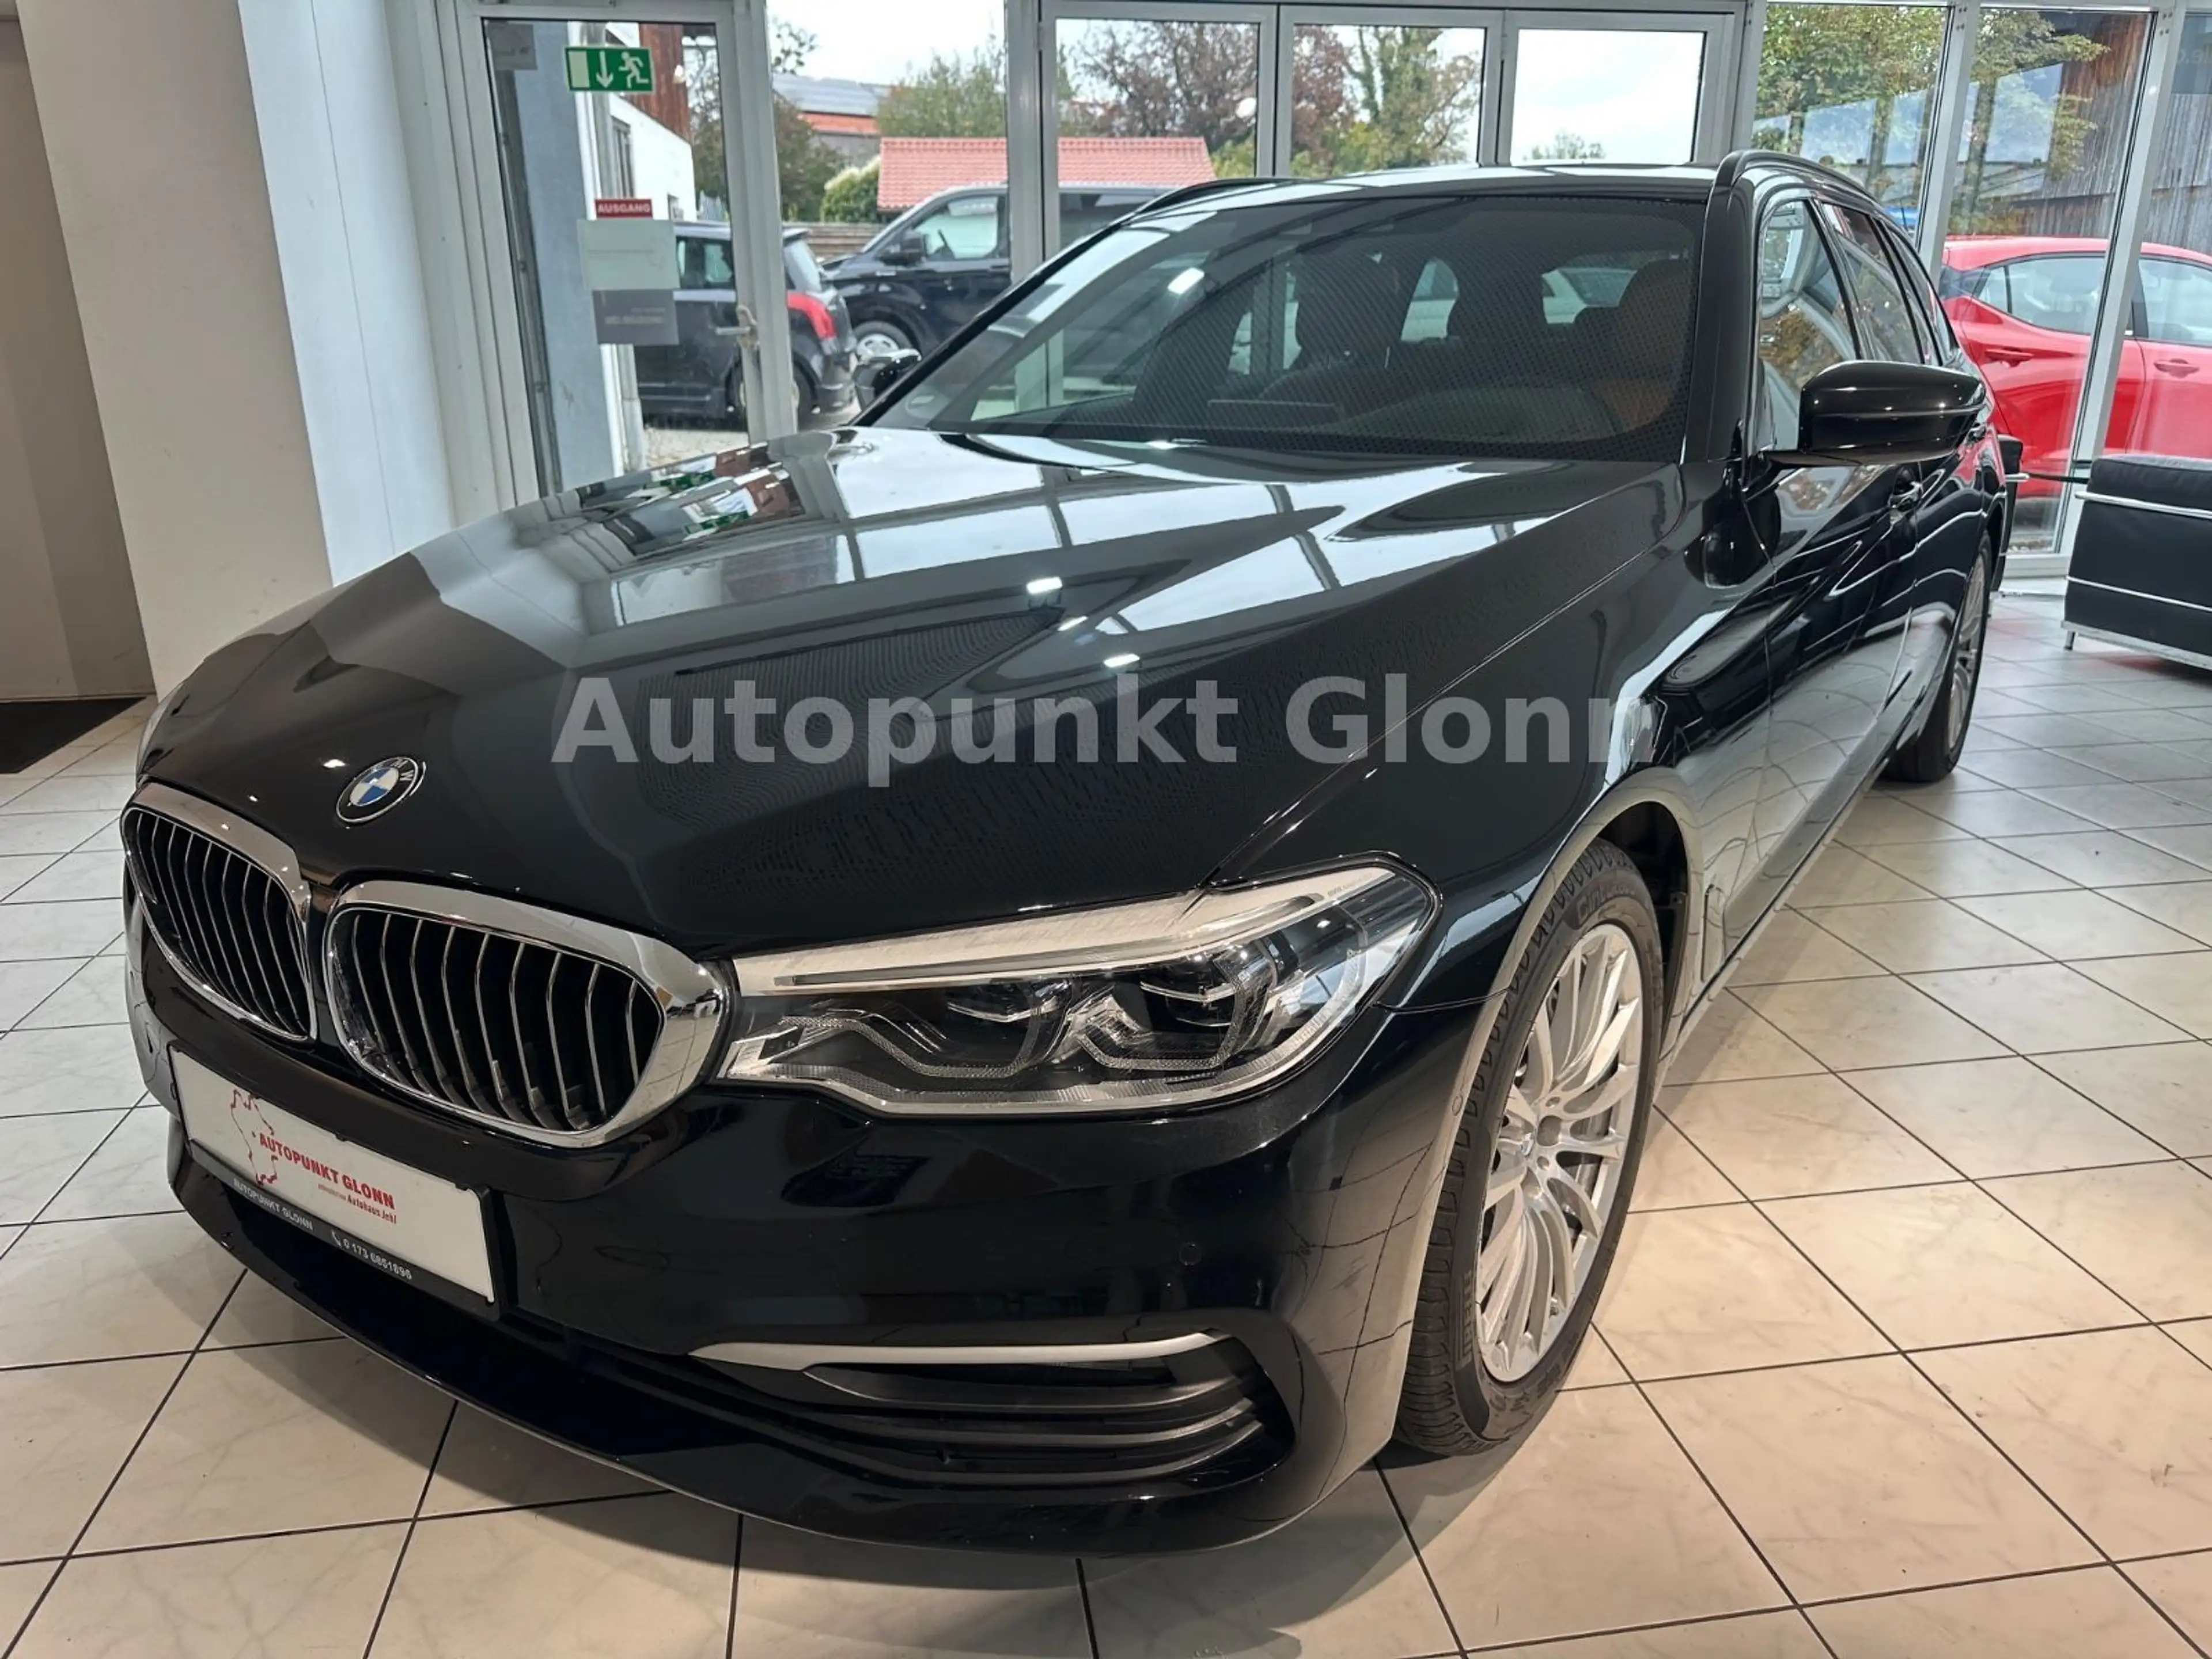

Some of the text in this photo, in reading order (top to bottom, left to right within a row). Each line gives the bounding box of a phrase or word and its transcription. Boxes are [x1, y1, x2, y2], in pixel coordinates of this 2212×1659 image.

[598, 203, 650, 213] AUSGANG
[260, 1132, 395, 1210] AUTOPUNKT GLONN
[233, 1178, 313, 1231] AUTOPUNKT GLONN
